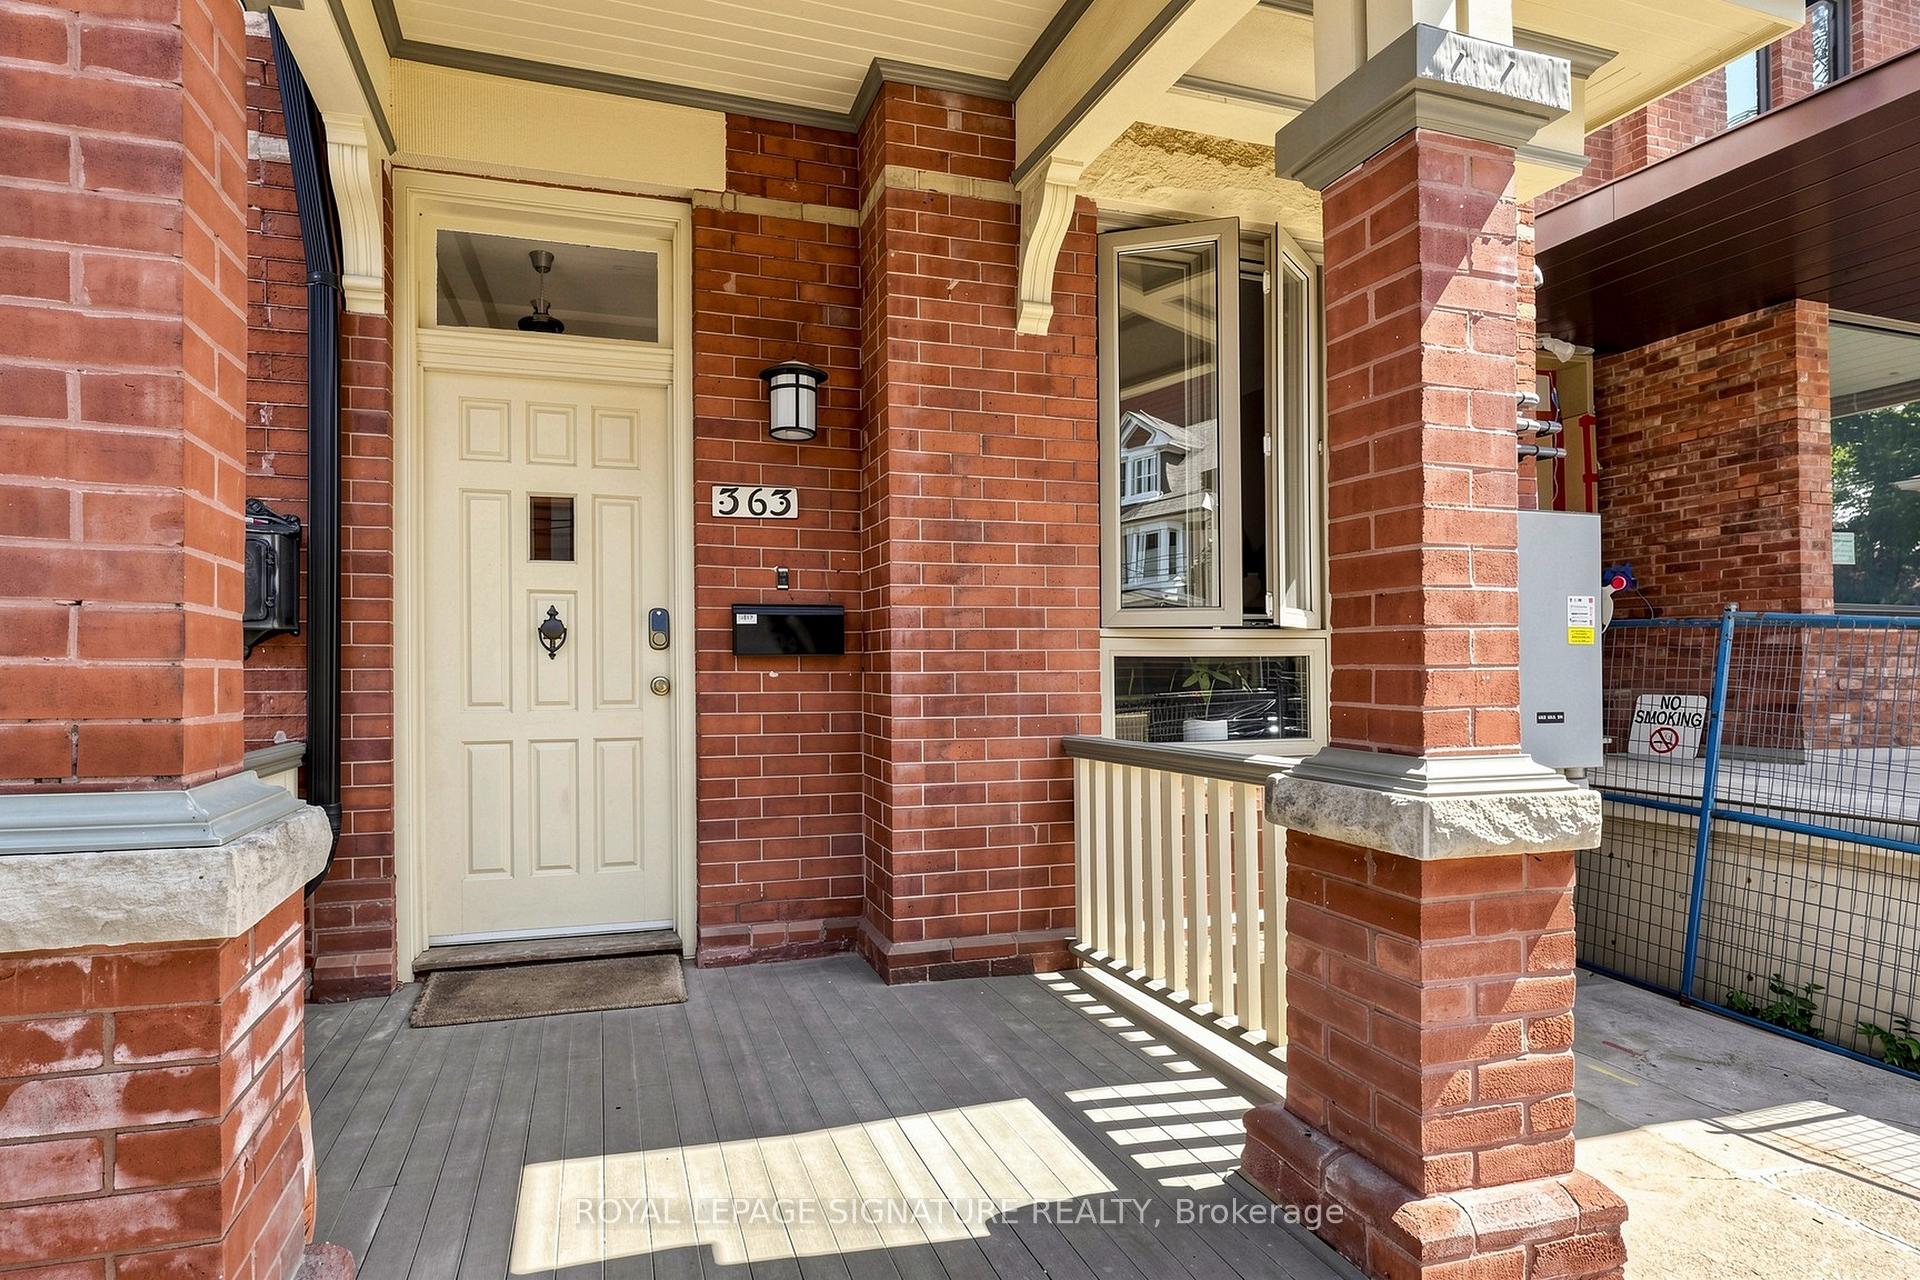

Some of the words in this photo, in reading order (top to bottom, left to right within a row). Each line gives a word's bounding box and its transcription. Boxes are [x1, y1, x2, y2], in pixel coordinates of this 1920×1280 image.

[719, 487, 792, 516] 363
[1661, 696, 1682, 710] NO
[1635, 710, 1703, 727] SMOKING
